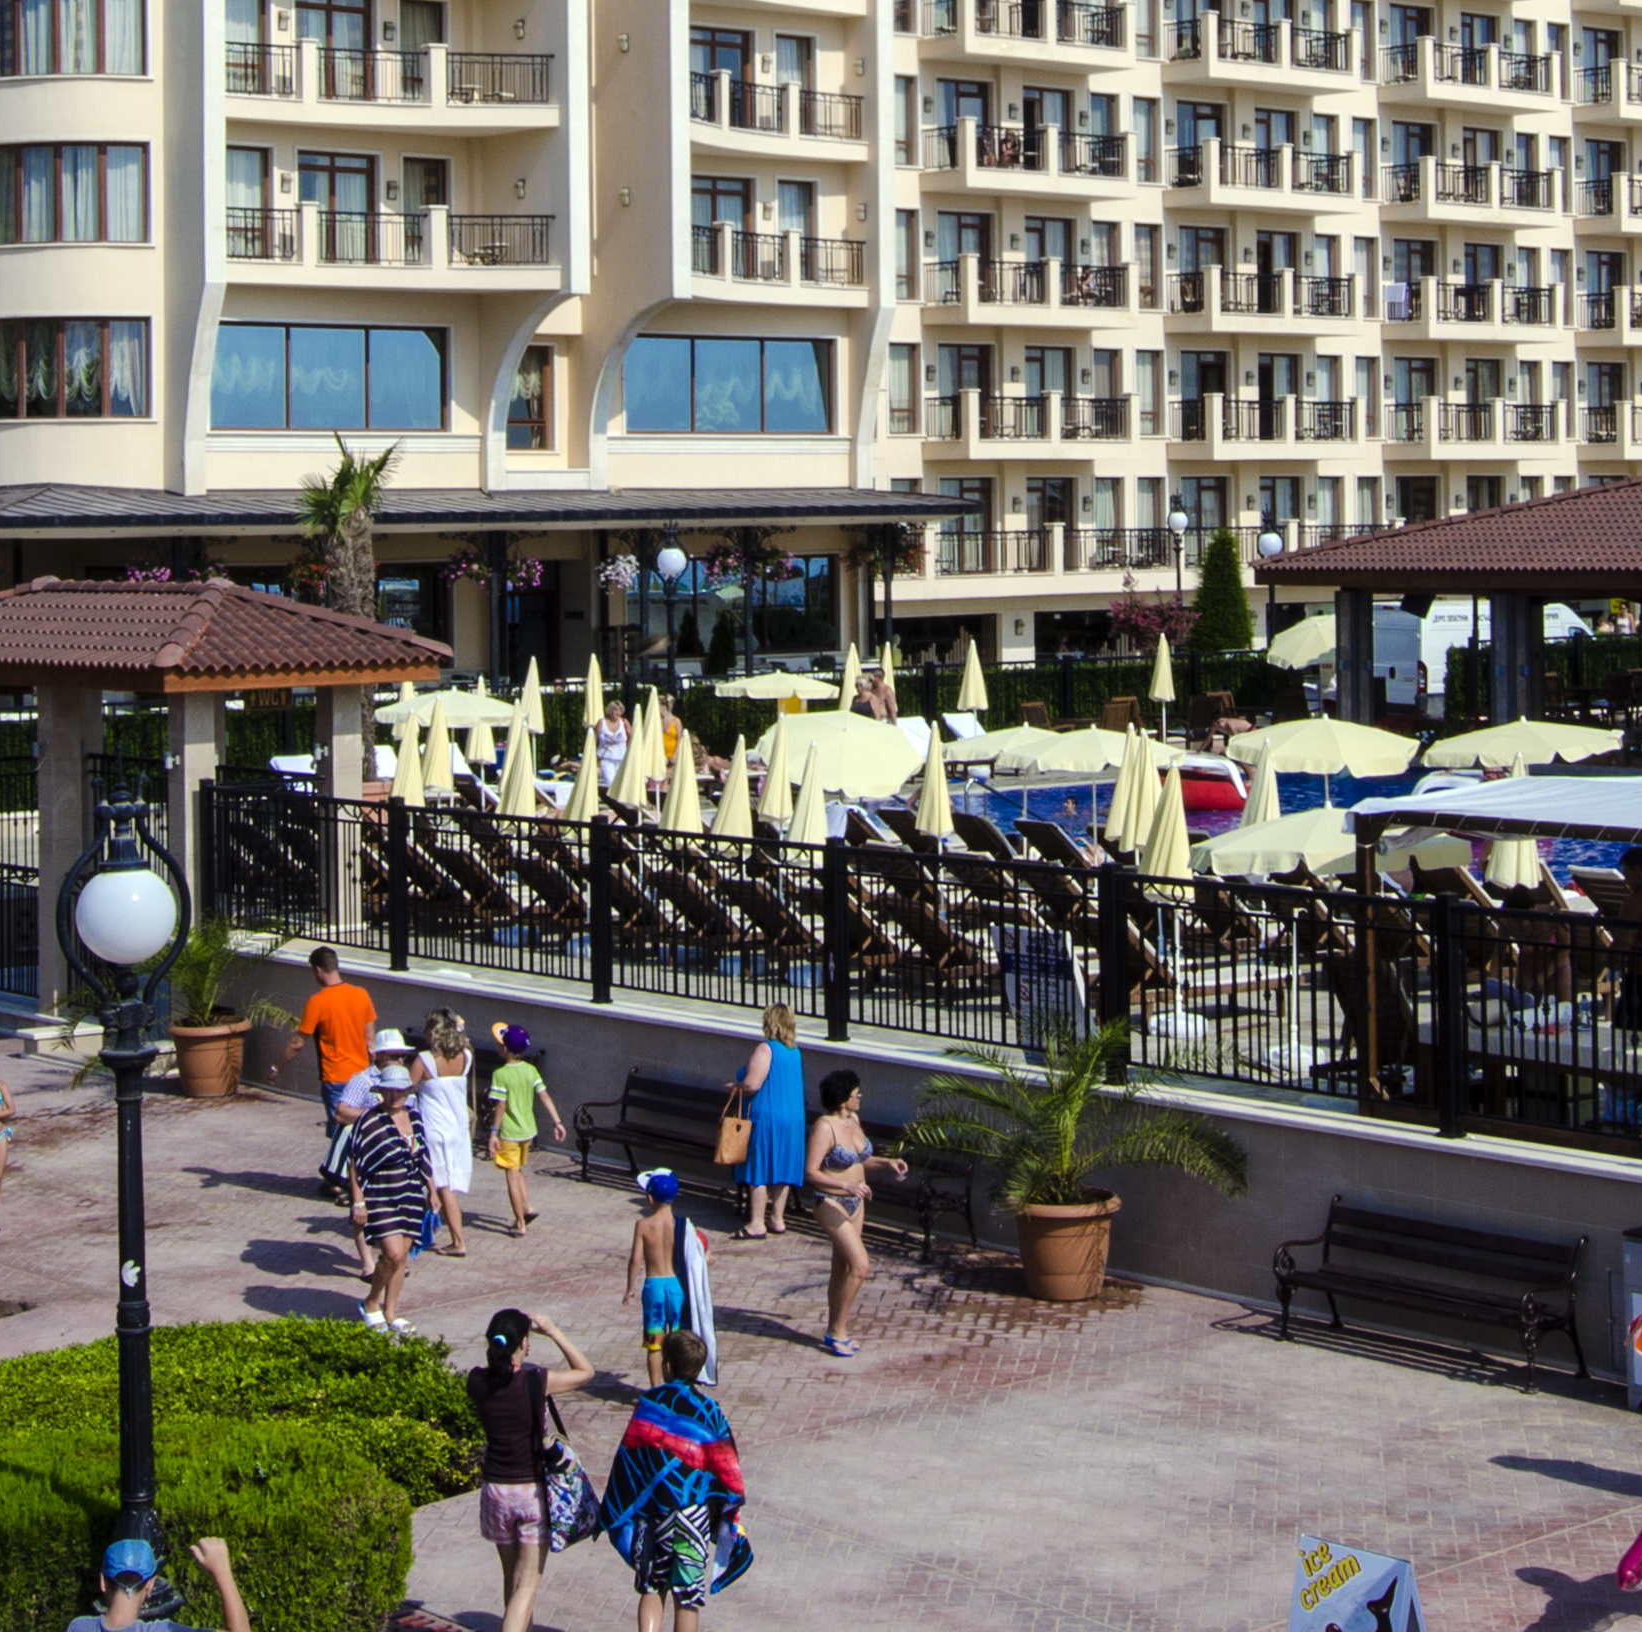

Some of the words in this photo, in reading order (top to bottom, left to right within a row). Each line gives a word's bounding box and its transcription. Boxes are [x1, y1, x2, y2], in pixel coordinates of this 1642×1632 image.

[259, 688, 279, 706] WC
[1299, 1542, 1333, 1578] ice
[1299, 1553, 1361, 1611] cream
